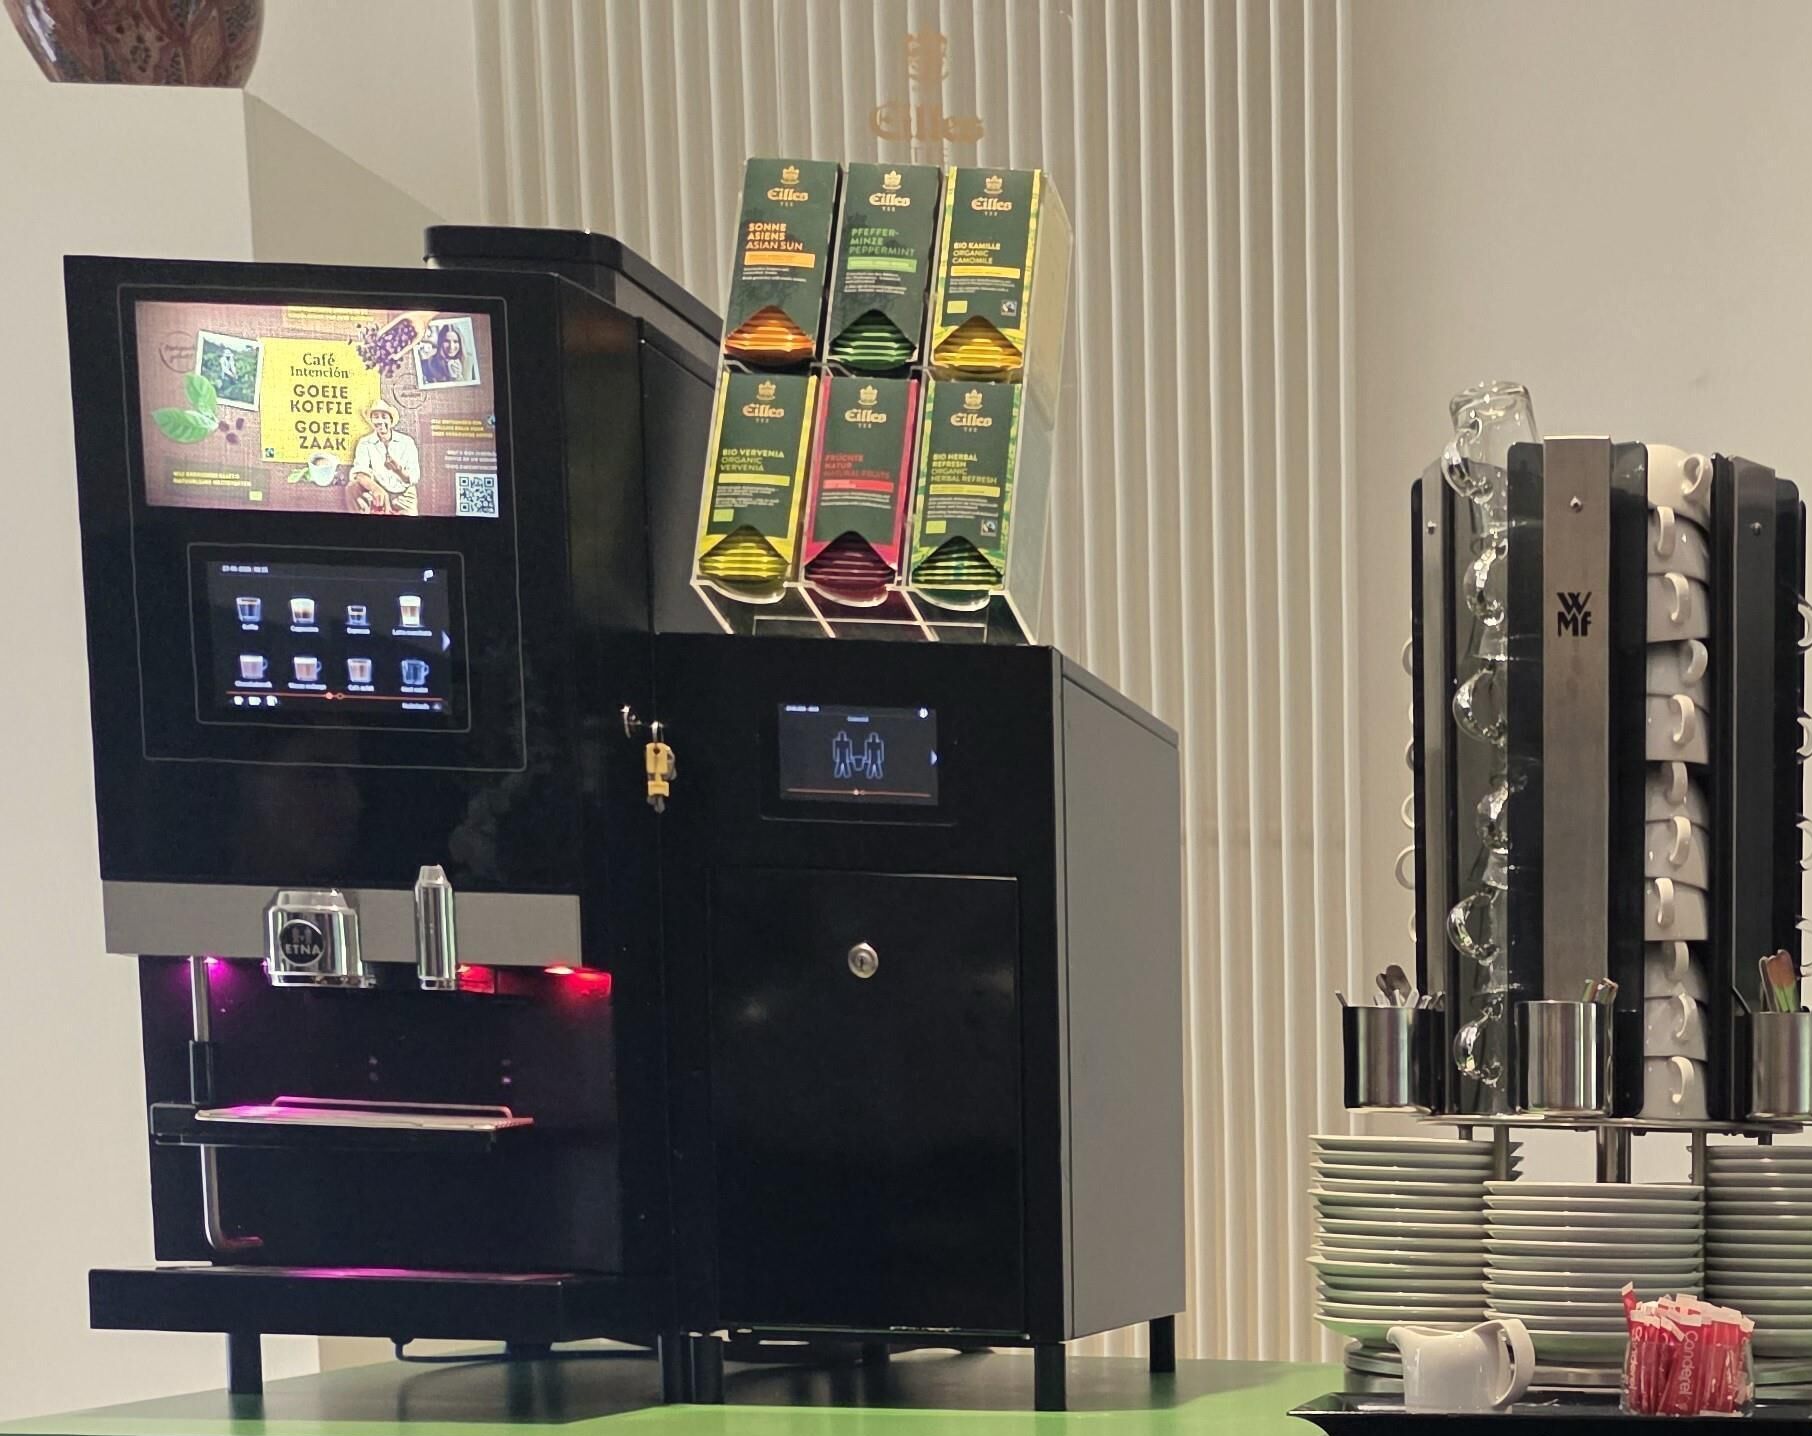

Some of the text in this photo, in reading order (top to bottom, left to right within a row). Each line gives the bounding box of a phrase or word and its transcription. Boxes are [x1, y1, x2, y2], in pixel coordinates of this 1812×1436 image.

[748, 222, 787, 231] SONNE
[851, 227, 899, 237] PFEFFER-
[747, 232, 786, 241] ASIENS
[850, 237, 883, 246] MINZE
[745, 241, 803, 250] ASIAN SUN
[968, 242, 1001, 250] KAMILLE
[849, 246, 915, 257] PEPPERMINT
[302, 353, 336, 366] Café
[290, 366, 349, 379] Intención
[293, 384, 348, 399] GOEIE
[290, 399, 353, 414] KOFFIE
[294, 420, 350, 435] GOEIE
[299, 436, 347, 450] ZAAK
[722, 448, 738, 457] BIO
[932, 453, 977, 462] BIO HERBAL
[721, 456, 763, 465] ORGANIC
[1557, 591, 1593, 637] WMF
[285, 943, 321, 954] ETNA
[1679, 1330, 1698, 1396] Canderel
